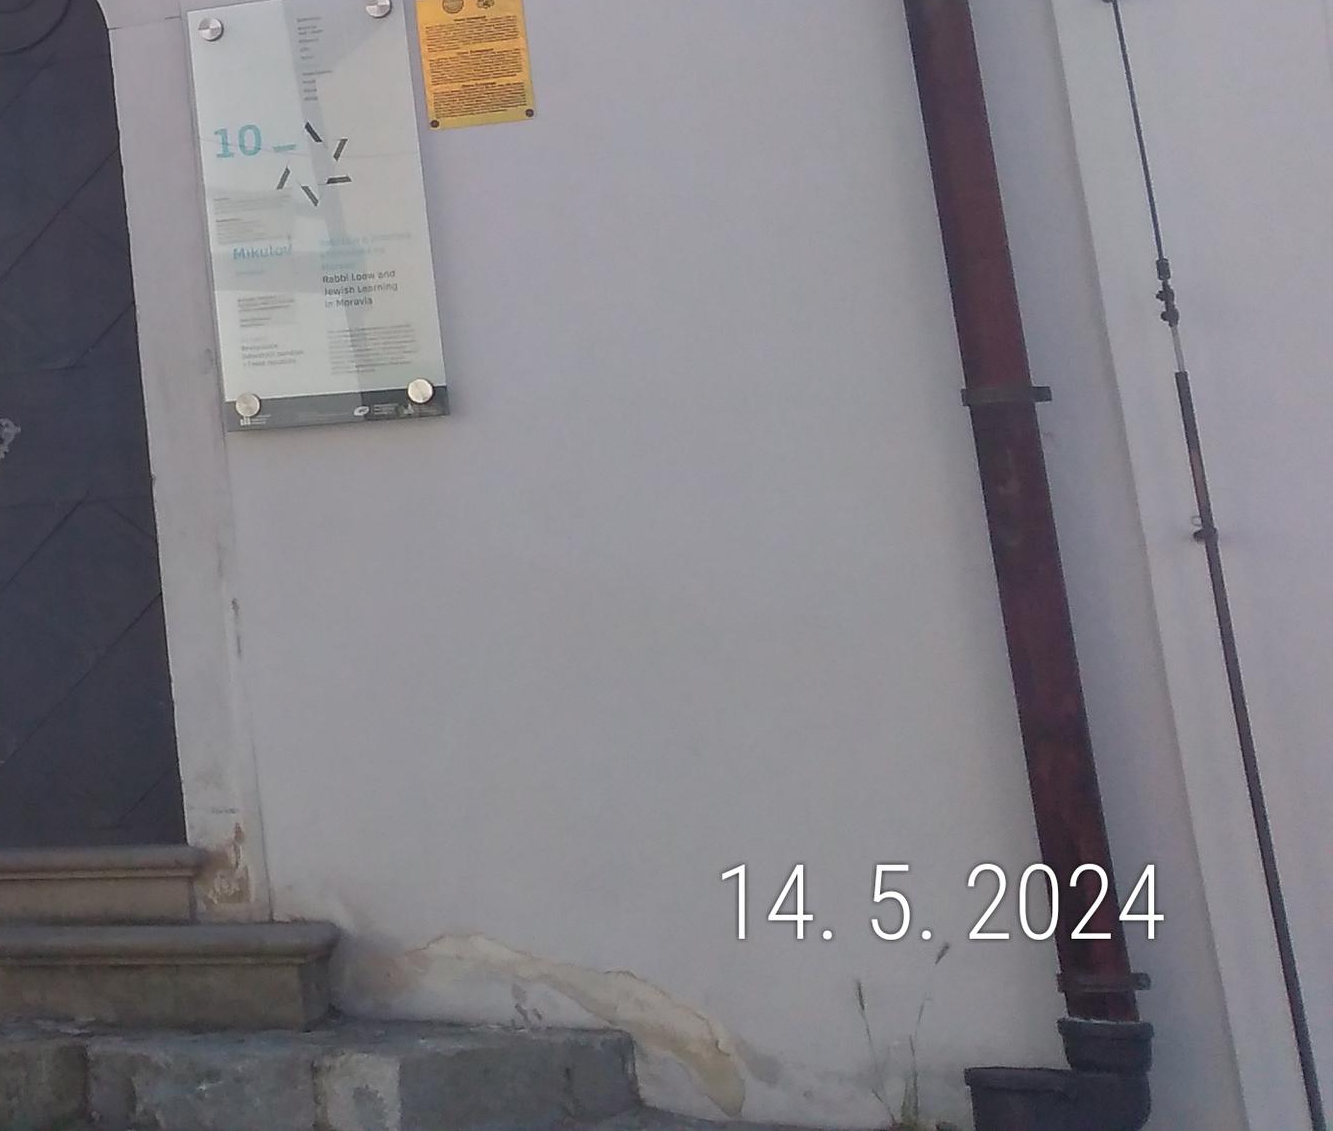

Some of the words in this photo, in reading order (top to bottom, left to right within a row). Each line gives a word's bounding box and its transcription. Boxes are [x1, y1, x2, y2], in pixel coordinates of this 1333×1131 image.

[213, 123, 263, 159] 10
[232, 243, 293, 260] Mikulov
[322, 273, 349, 284] Rabbi
[378, 270, 396, 280] and
[324, 286, 356, 296] Jewish
[357, 282, 399, 294] Learning
[336, 296, 374, 308] Moravia
